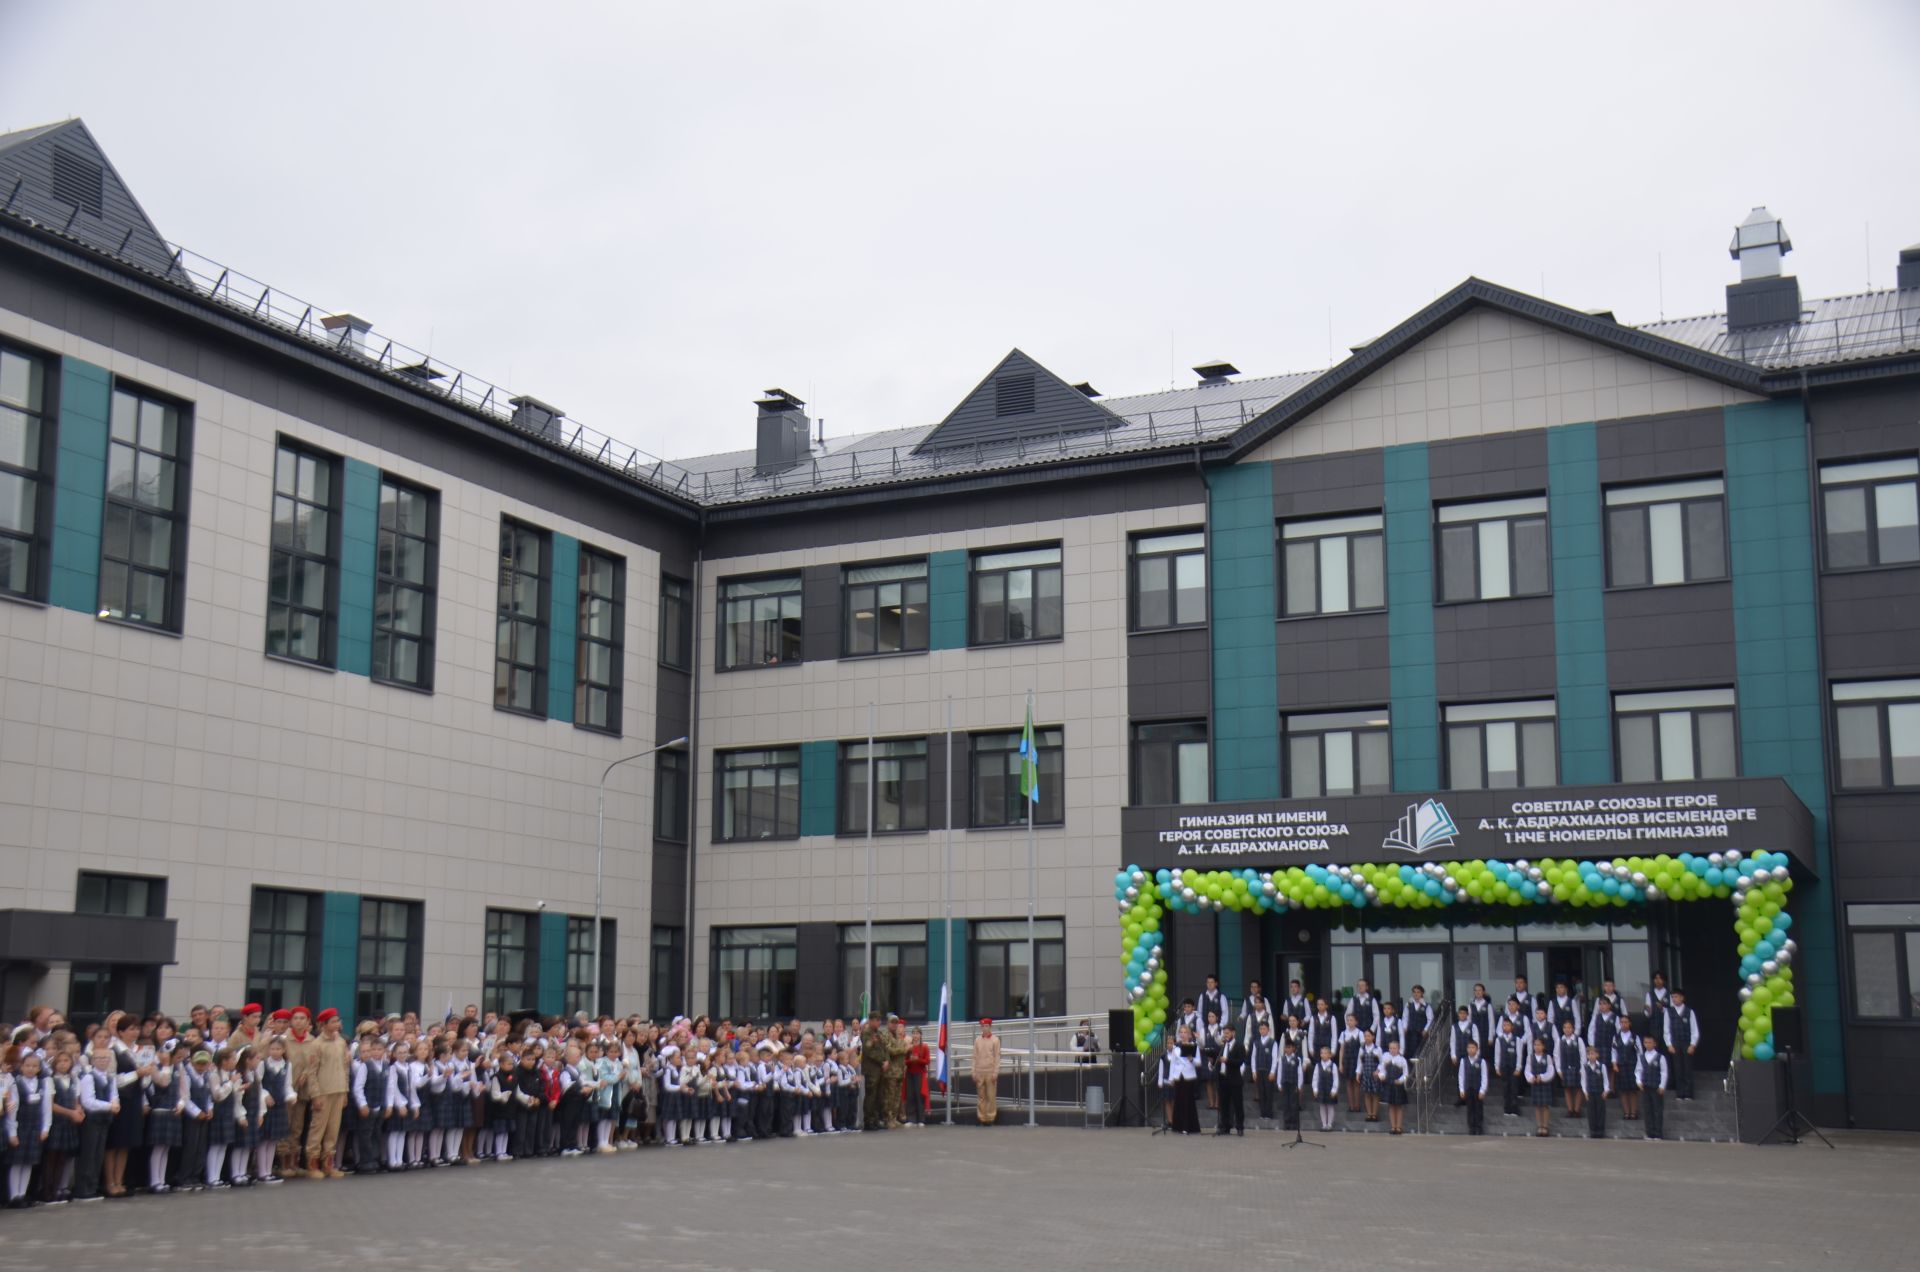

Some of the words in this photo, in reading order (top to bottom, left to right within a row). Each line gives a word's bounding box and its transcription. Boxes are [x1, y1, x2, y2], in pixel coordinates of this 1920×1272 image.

[1511, 799, 1595, 814] СОВЕТЛАР
[1598, 797, 1662, 811] СОЮЗЫ
[1665, 794, 1718, 808] ГЕРОЕ
[1179, 814, 1254, 828] ГИМНАЗИЯ
[1275, 811, 1327, 823] ИМЕНИ
[1478, 818, 1495, 830] А.
[1497, 817, 1513, 829] К.
[1515, 812, 1640, 829] АБДРАХМАНОВ
[1643, 807, 1757, 824] ИСЕМЕНДӘГЕ
[1159, 829, 1202, 843] ГЕРОЯ
[1204, 825, 1294, 841] СОВЕТСКОГО
[1296, 823, 1350, 837] СОЮЗА
[1504, 832, 1512, 844] 1
[1514, 830, 1547, 843] НЧЕ
[1549, 828, 1633, 842] НОМЕРЛЫ
[1636, 824, 1729, 840] ГИМНАЗИЯ
[1177, 844, 1192, 856] А.
[1195, 843, 1208, 855] К.
[1210, 838, 1330, 855] АБДРАХМАНОВА
